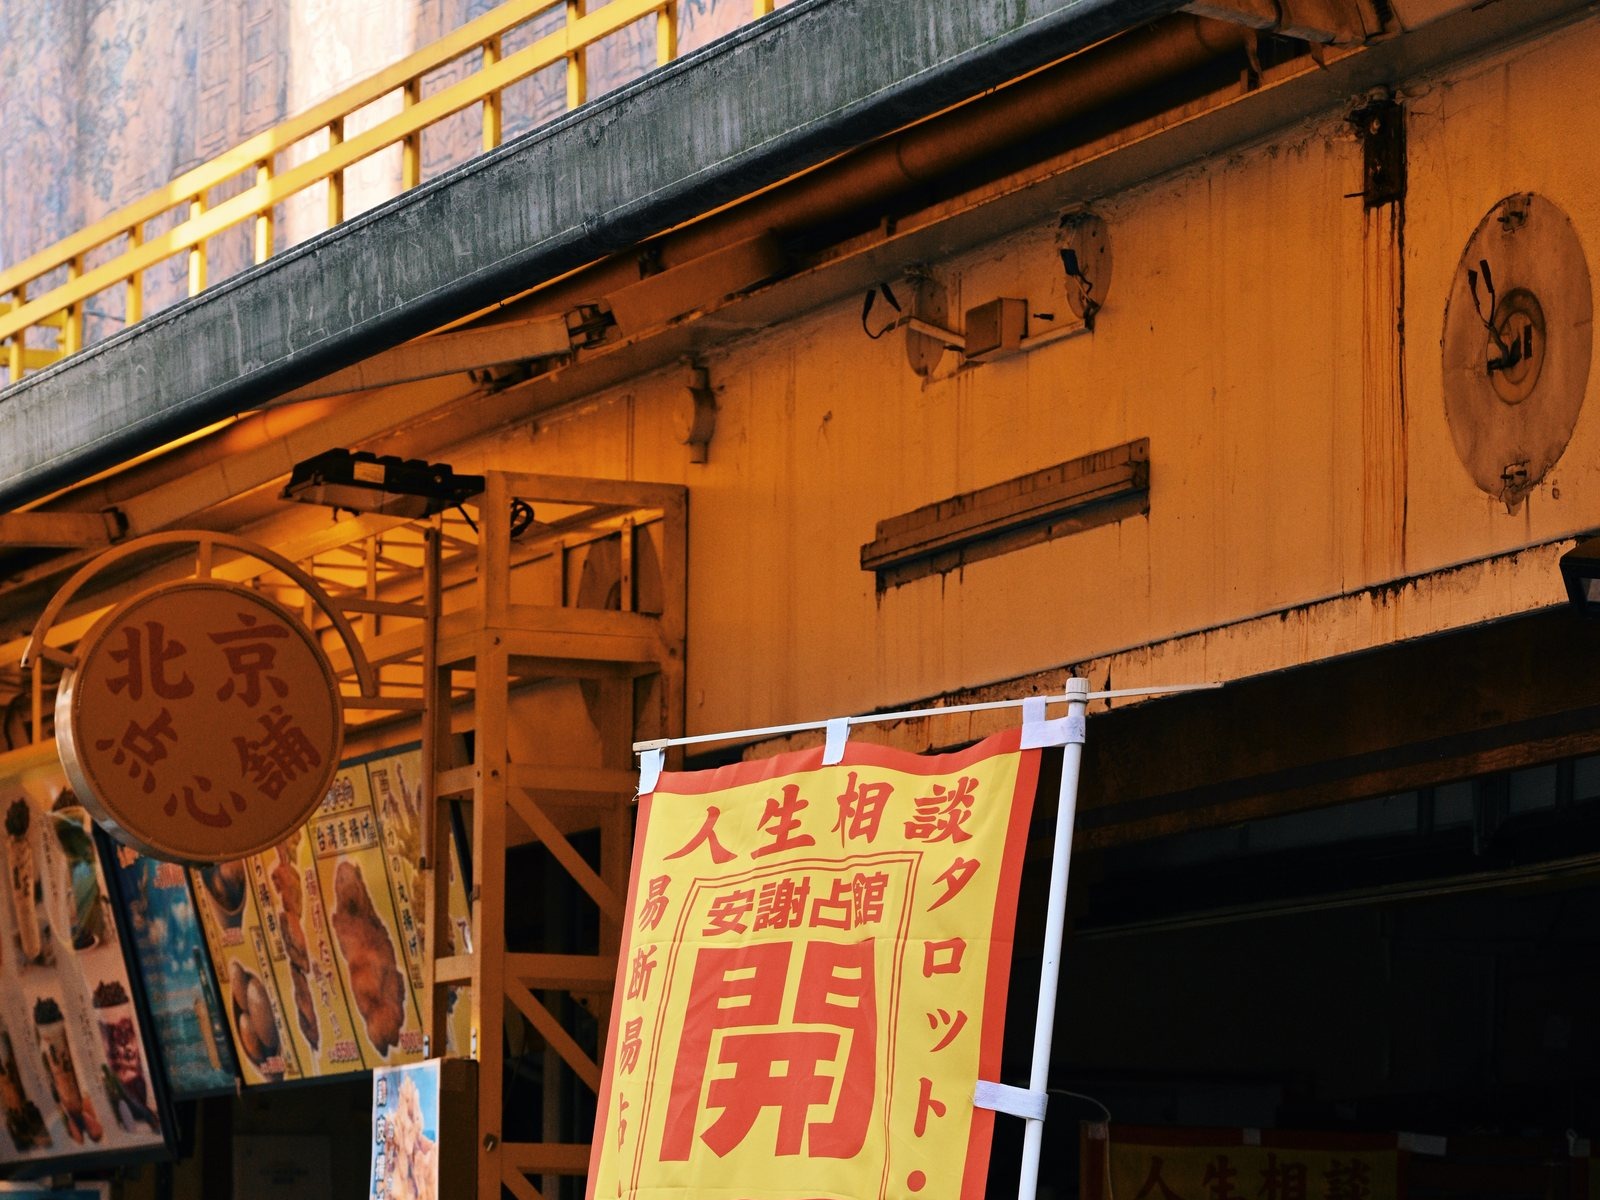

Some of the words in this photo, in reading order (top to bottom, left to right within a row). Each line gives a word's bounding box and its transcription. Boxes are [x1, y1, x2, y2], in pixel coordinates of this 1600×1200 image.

[105, 612, 290, 708] 北京
[663, 770, 980, 864] 人生相談
[701, 871, 889, 938] 安謝占館
